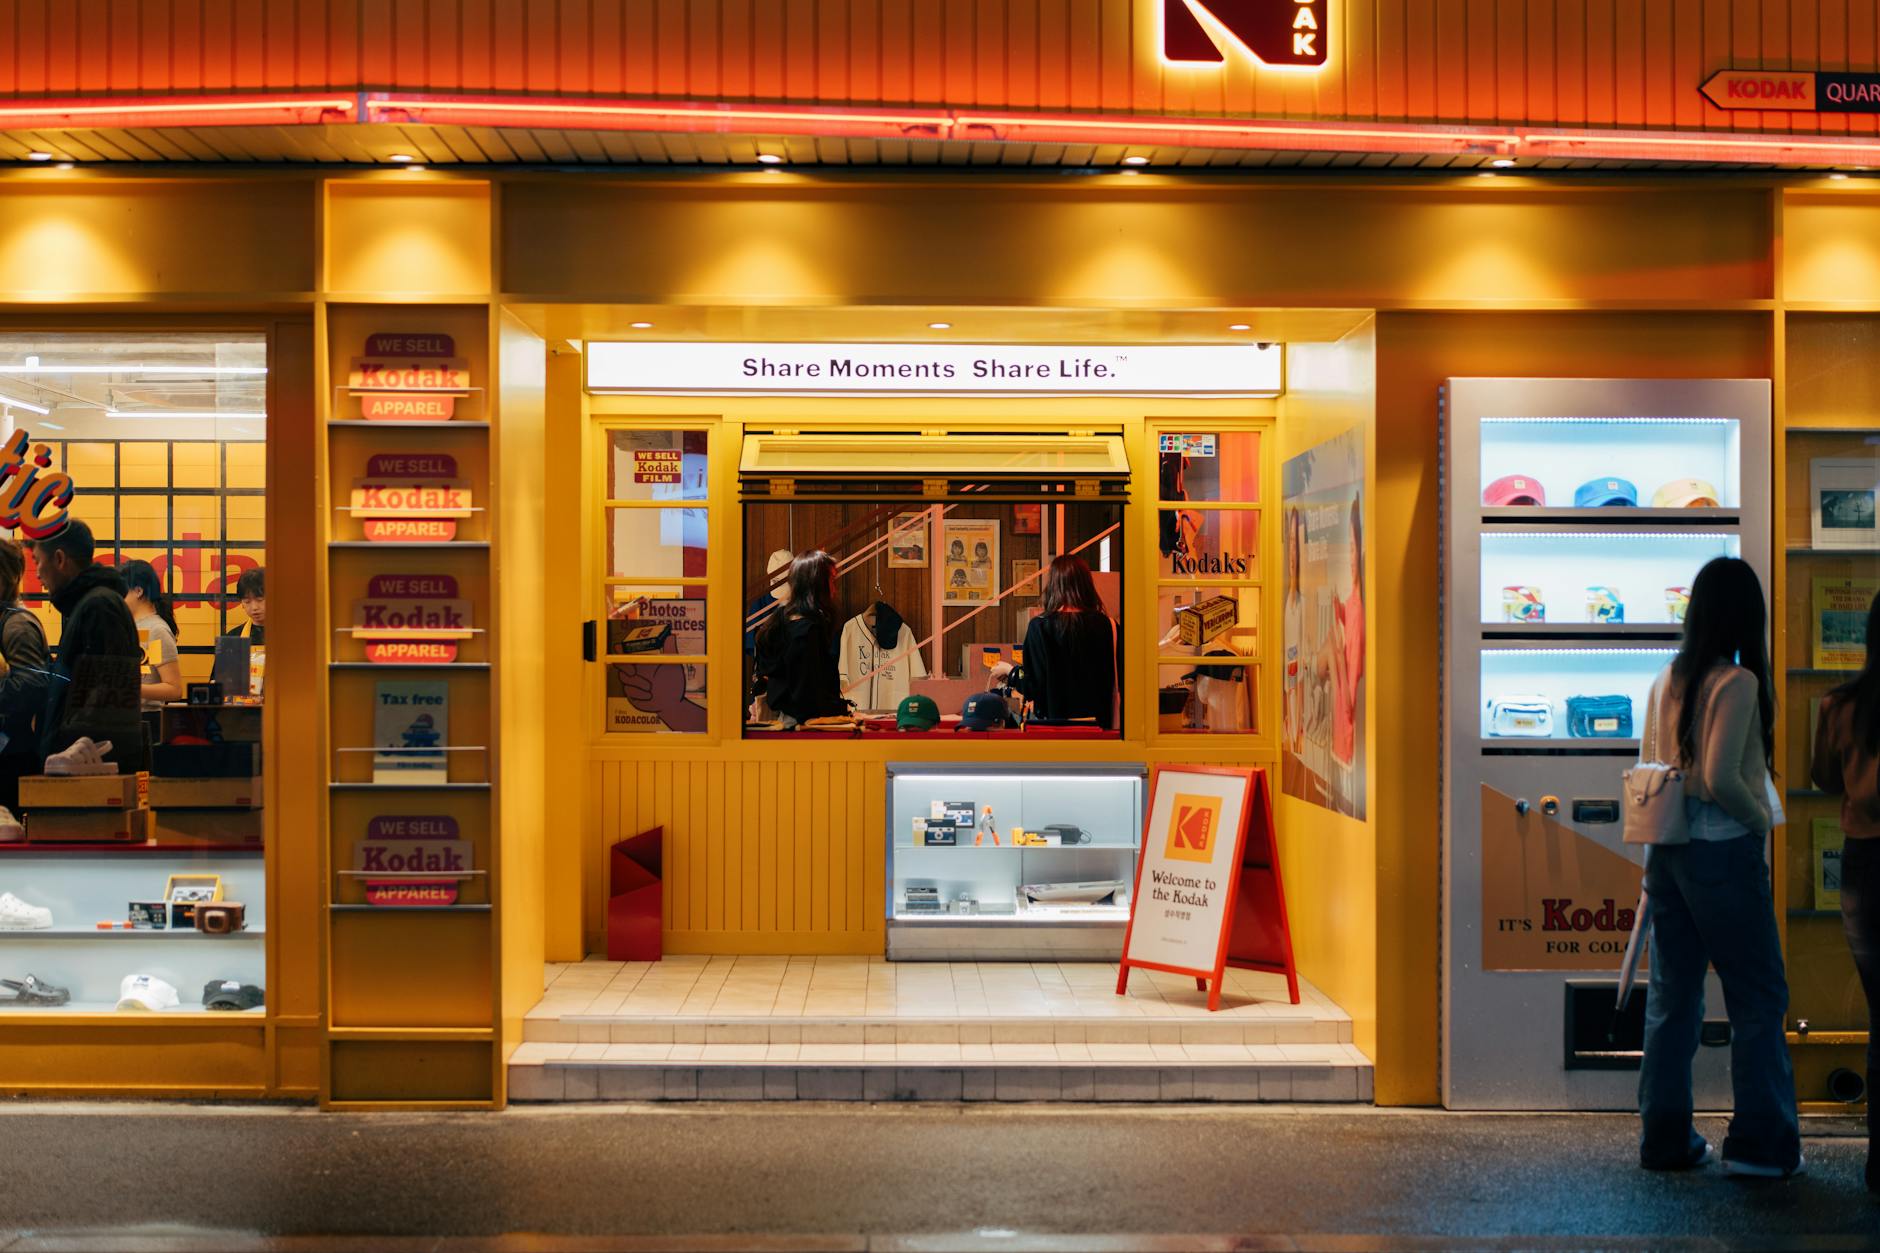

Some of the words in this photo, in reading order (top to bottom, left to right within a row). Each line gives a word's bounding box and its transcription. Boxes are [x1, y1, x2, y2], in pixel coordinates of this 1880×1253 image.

[1292, 0, 1318, 56] AK
[1728, 79, 1806, 100] KODAK
[1826, 82, 1880, 103] QUAR
[377, 339, 402, 352] WE
[406, 339, 445, 352] SELL
[742, 358, 821, 378] Share
[830, 359, 956, 378] Moments
[972, 358, 1051, 378] Share
[359, 364, 461, 388] Kodak
[371, 401, 446, 416] APPAREL
[638, 452, 653, 460] WE
[654, 452, 678, 460] SELL
[378, 460, 404, 473] WE
[407, 460, 446, 473] SELL
[637, 462, 679, 472] Kodak
[642, 474, 673, 482] FILM
[361, 485, 463, 509] Kodak
[373, 522, 448, 536] APPAREL
[380, 580, 406, 593] WE
[409, 580, 448, 593] SELL
[640, 602, 686, 617] Photos
[363, 605, 464, 629] Kodak
[374, 644, 450, 658] APPAREL
[381, 693, 408, 705] Tax
[413, 693, 444, 705] free
[379, 821, 406, 834] WE
[409, 821, 448, 834] SELL
[362, 847, 464, 871] Kodak
[1152, 869, 1201, 888] Welcome
[1205, 878, 1216, 890] to
[375, 885, 450, 899] APPAREL
[1152, 887, 1170, 901] the
[1173, 889, 1208, 907] Kodak
[1542, 899, 1639, 932] Koda
[1546, 941, 1580, 954] FOR
